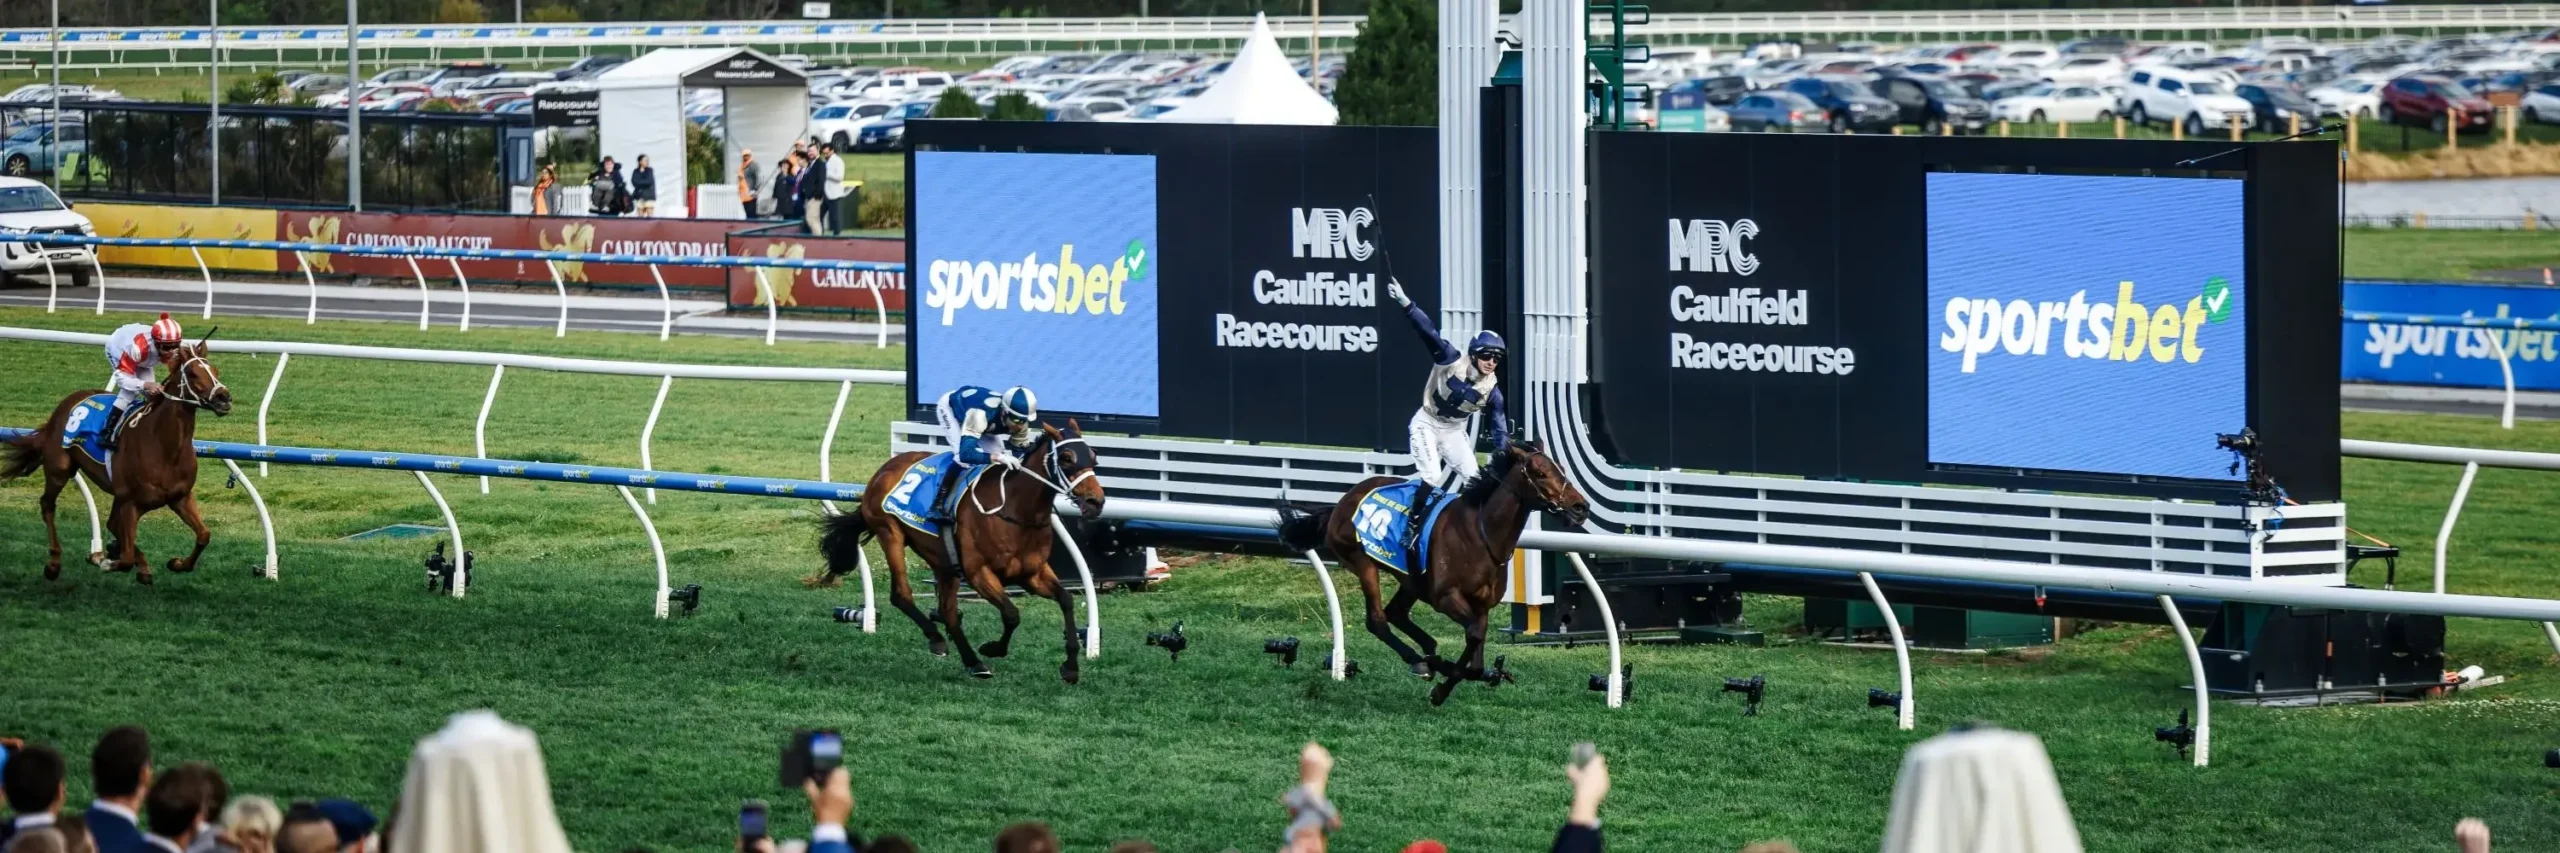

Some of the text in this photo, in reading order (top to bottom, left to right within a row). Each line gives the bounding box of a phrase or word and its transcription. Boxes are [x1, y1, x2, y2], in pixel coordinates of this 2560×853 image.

[538, 100, 599, 110] Racecourse
[1292, 207, 1375, 261] MRC
[1669, 218, 1760, 276] MRC
[926, 244, 1129, 326] sportsbet
[1253, 269, 1376, 307] Caulfield
[1670, 285, 1808, 325] Caulfield
[1216, 313, 1378, 352] Racecourse
[1940, 280, 2208, 373] sportsbet
[1671, 332, 1855, 375] Racecourse
[65, 406, 89, 433] 8
[372, 456, 398, 466] sportsbet
[434, 460, 460, 470] sportsbet
[498, 465, 525, 475] sportsbet
[562, 469, 591, 479] sportsbet
[628, 474, 656, 484] sportsbet
[696, 478, 726, 489] sportsbet
[765, 483, 796, 494] sportsbet
[891, 473, 922, 505] 2
[885, 500, 926, 525] sportsbet
[1356, 503, 1393, 541] 10
